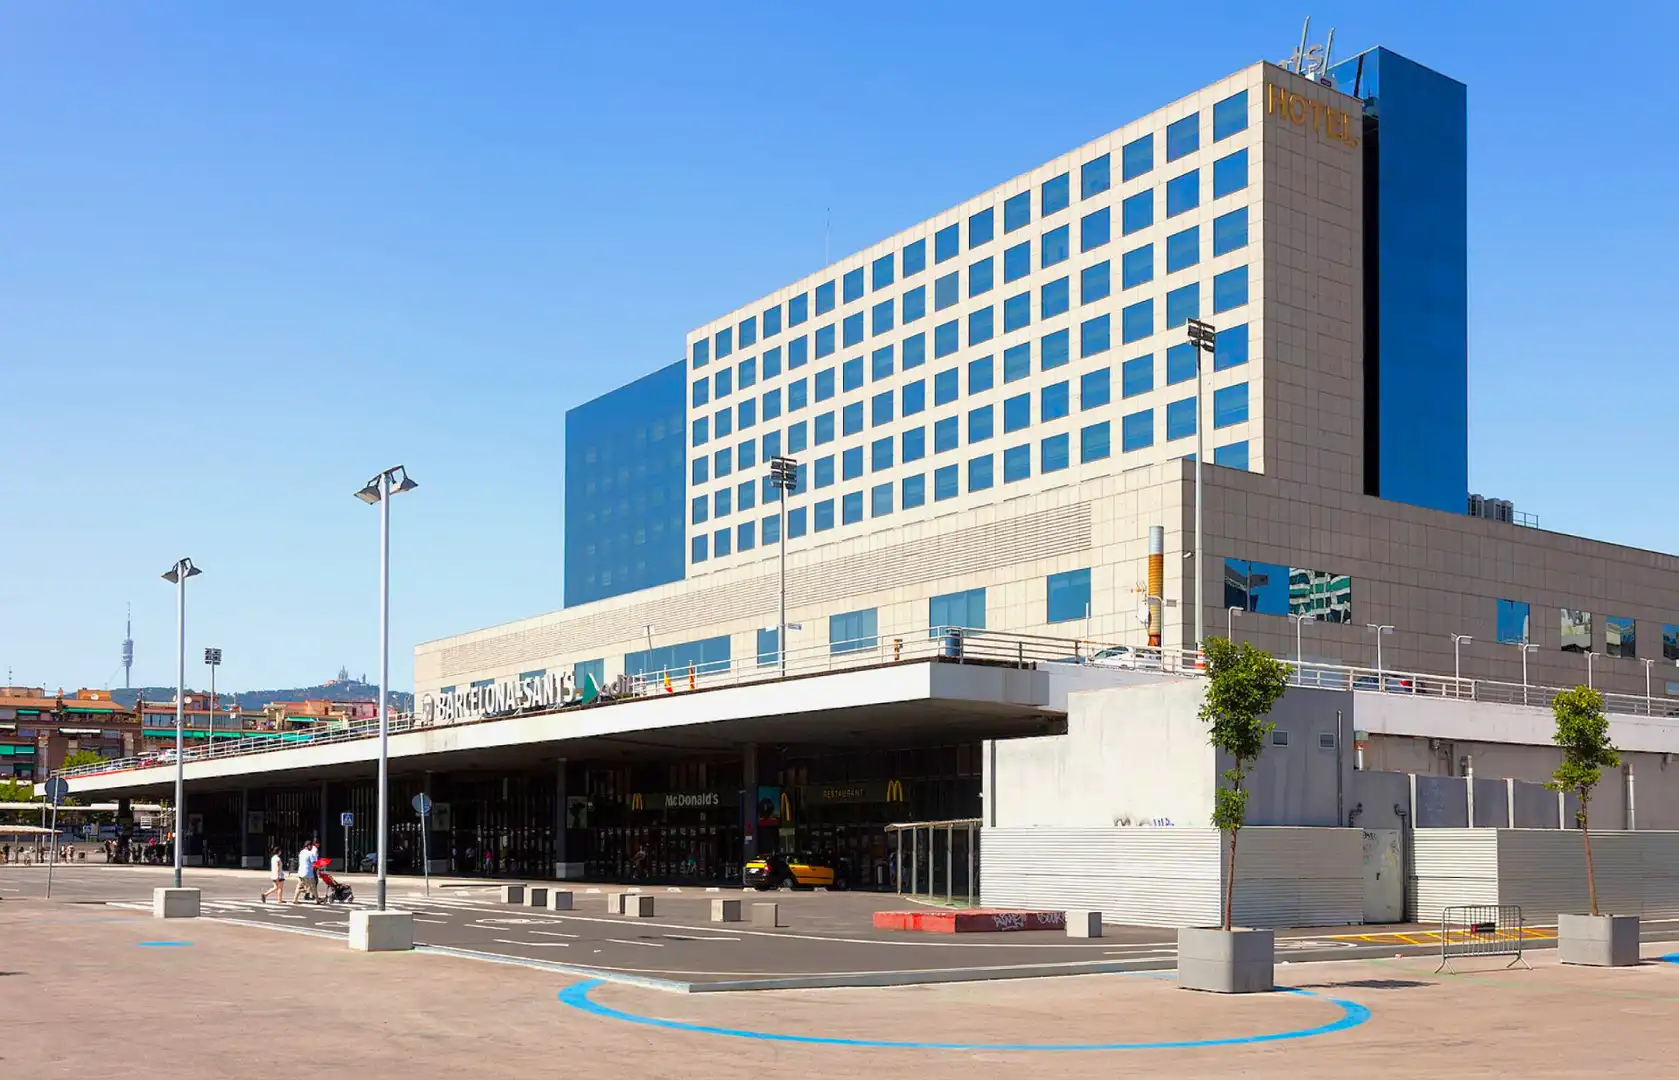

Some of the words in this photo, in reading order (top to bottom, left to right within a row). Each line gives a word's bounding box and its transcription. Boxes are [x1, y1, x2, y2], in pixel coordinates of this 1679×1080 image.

[1268, 84, 1358, 148] HOTEL
[437, 671, 575, 719] BARCELONA-SANTS
[665, 792, 719, 807] McDonald's
